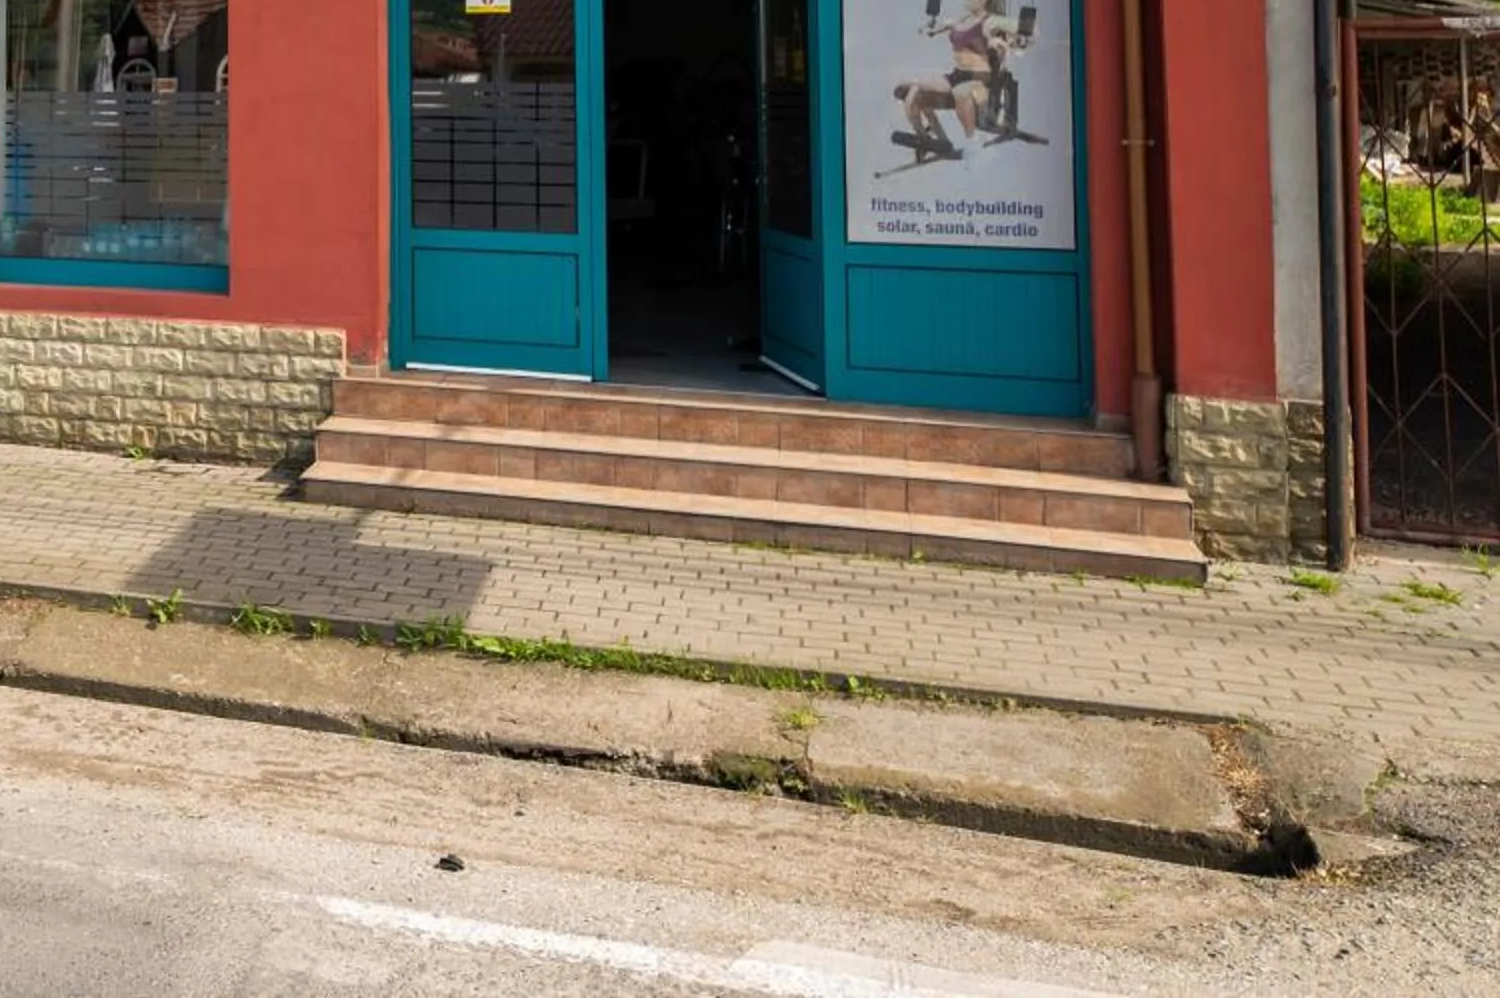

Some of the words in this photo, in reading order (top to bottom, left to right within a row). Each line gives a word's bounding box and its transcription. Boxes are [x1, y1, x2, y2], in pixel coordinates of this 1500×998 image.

[870, 197, 931, 216] fitness,
[935, 199, 1045, 219] bodybuilding
[877, 219, 921, 235] solar,
[984, 222, 1039, 238] cardio
